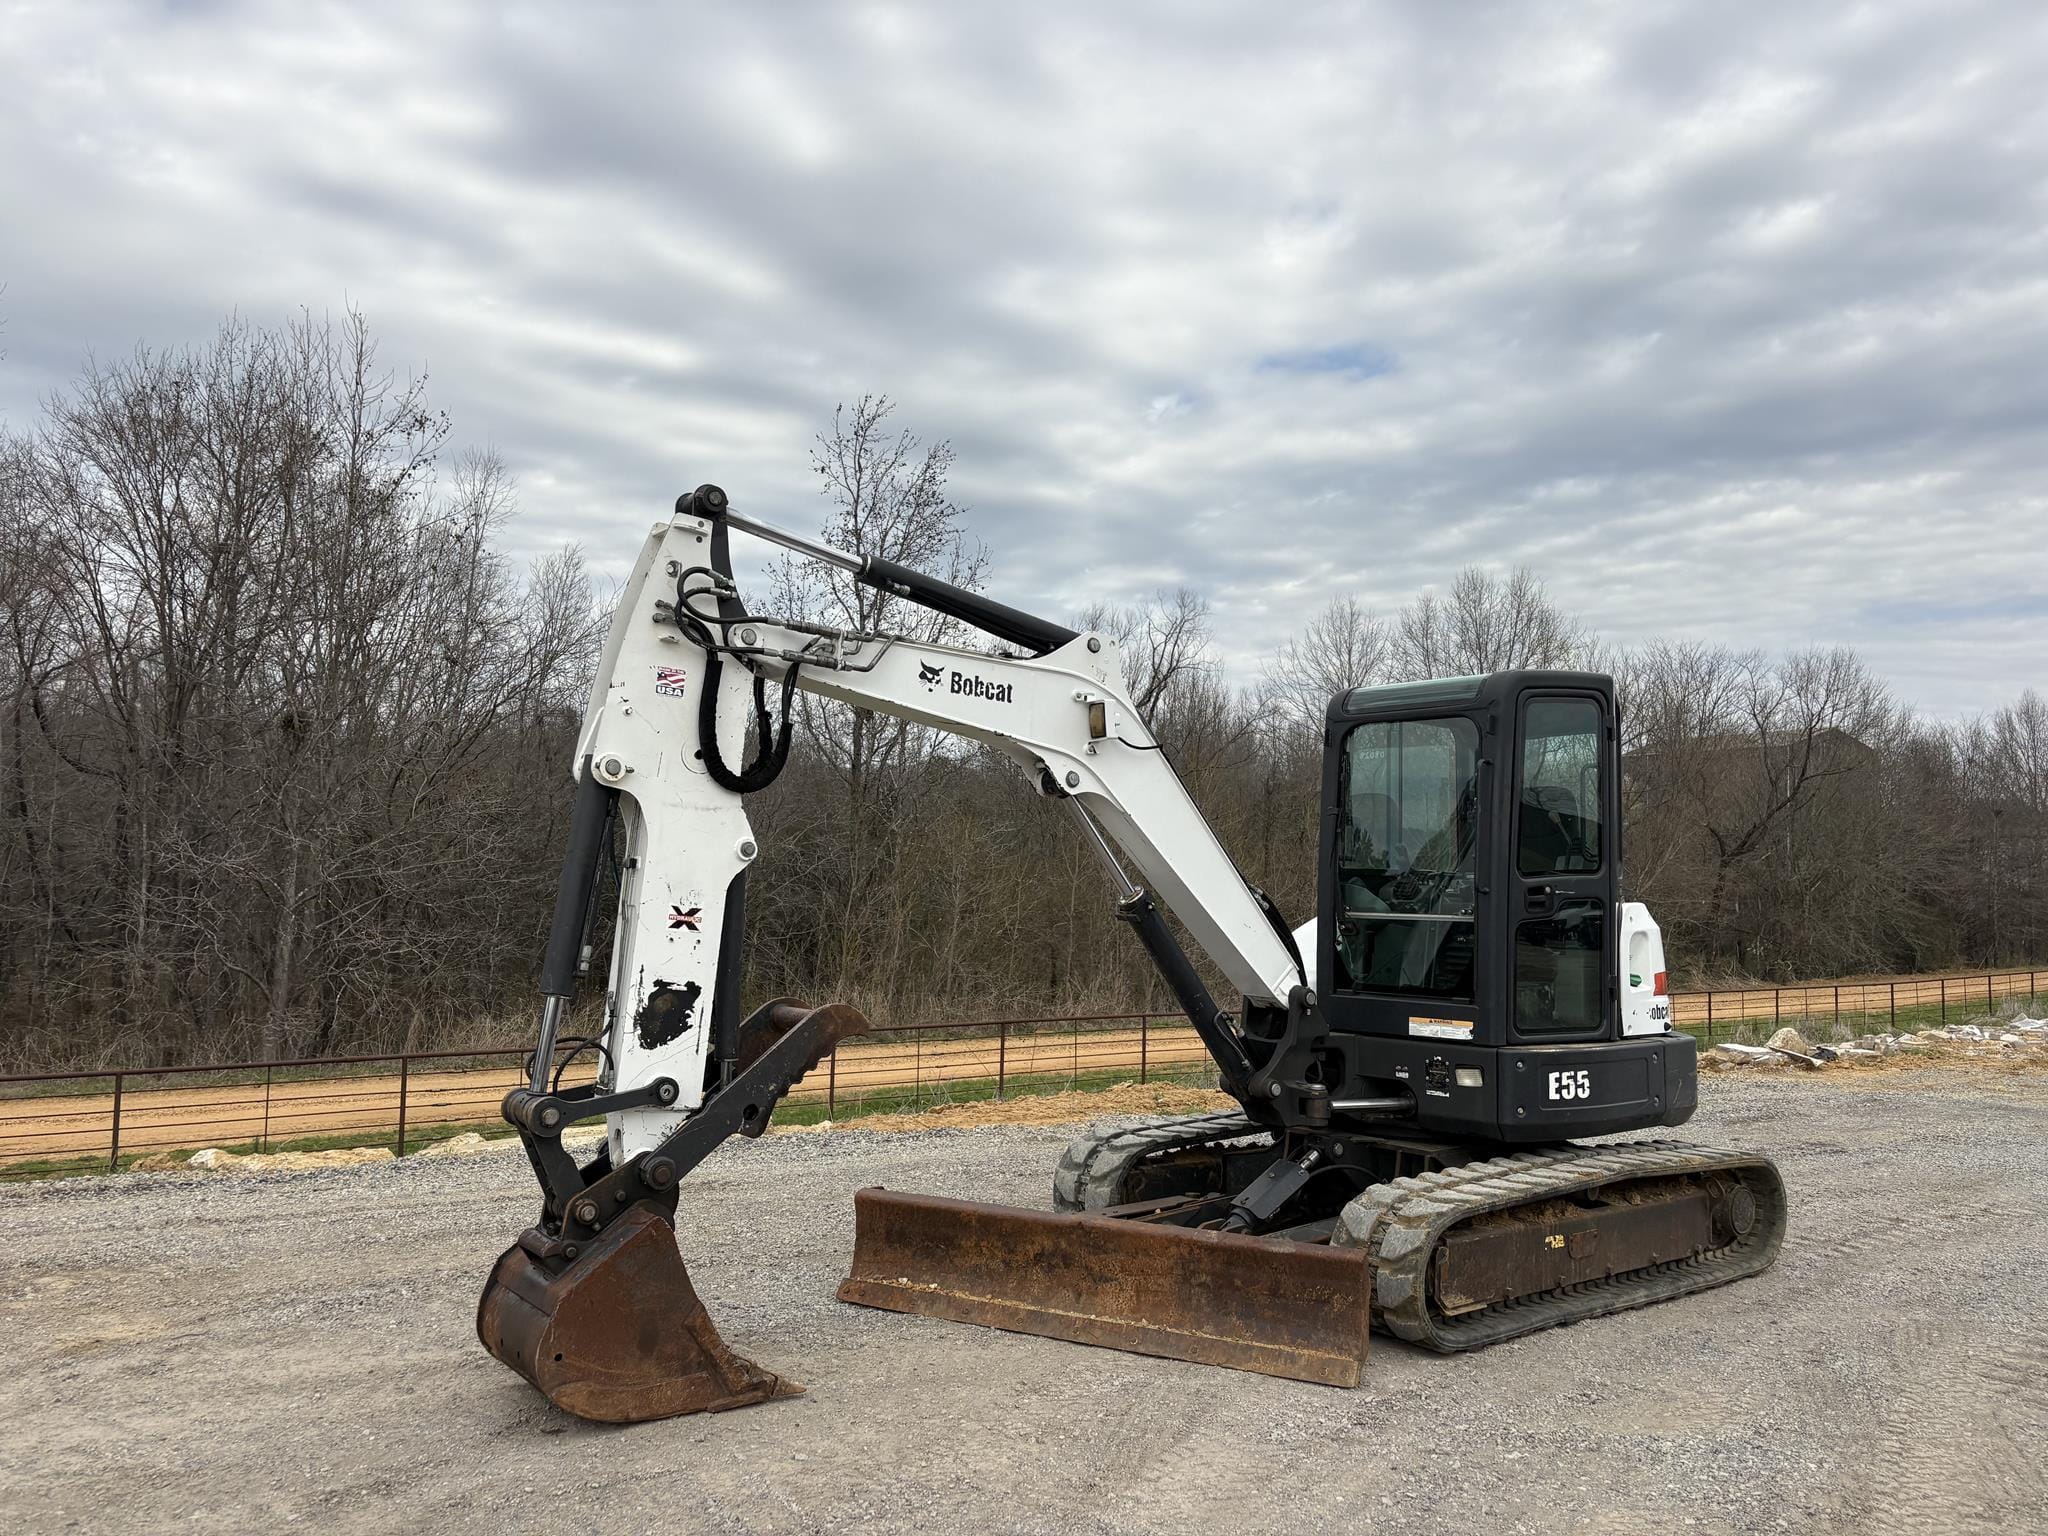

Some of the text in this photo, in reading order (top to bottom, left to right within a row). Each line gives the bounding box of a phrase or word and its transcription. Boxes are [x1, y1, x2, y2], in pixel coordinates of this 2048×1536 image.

[656, 685, 683, 697] USA
[950, 671, 1013, 704] Bobcat
[1549, 1070, 1590, 1100] E55
